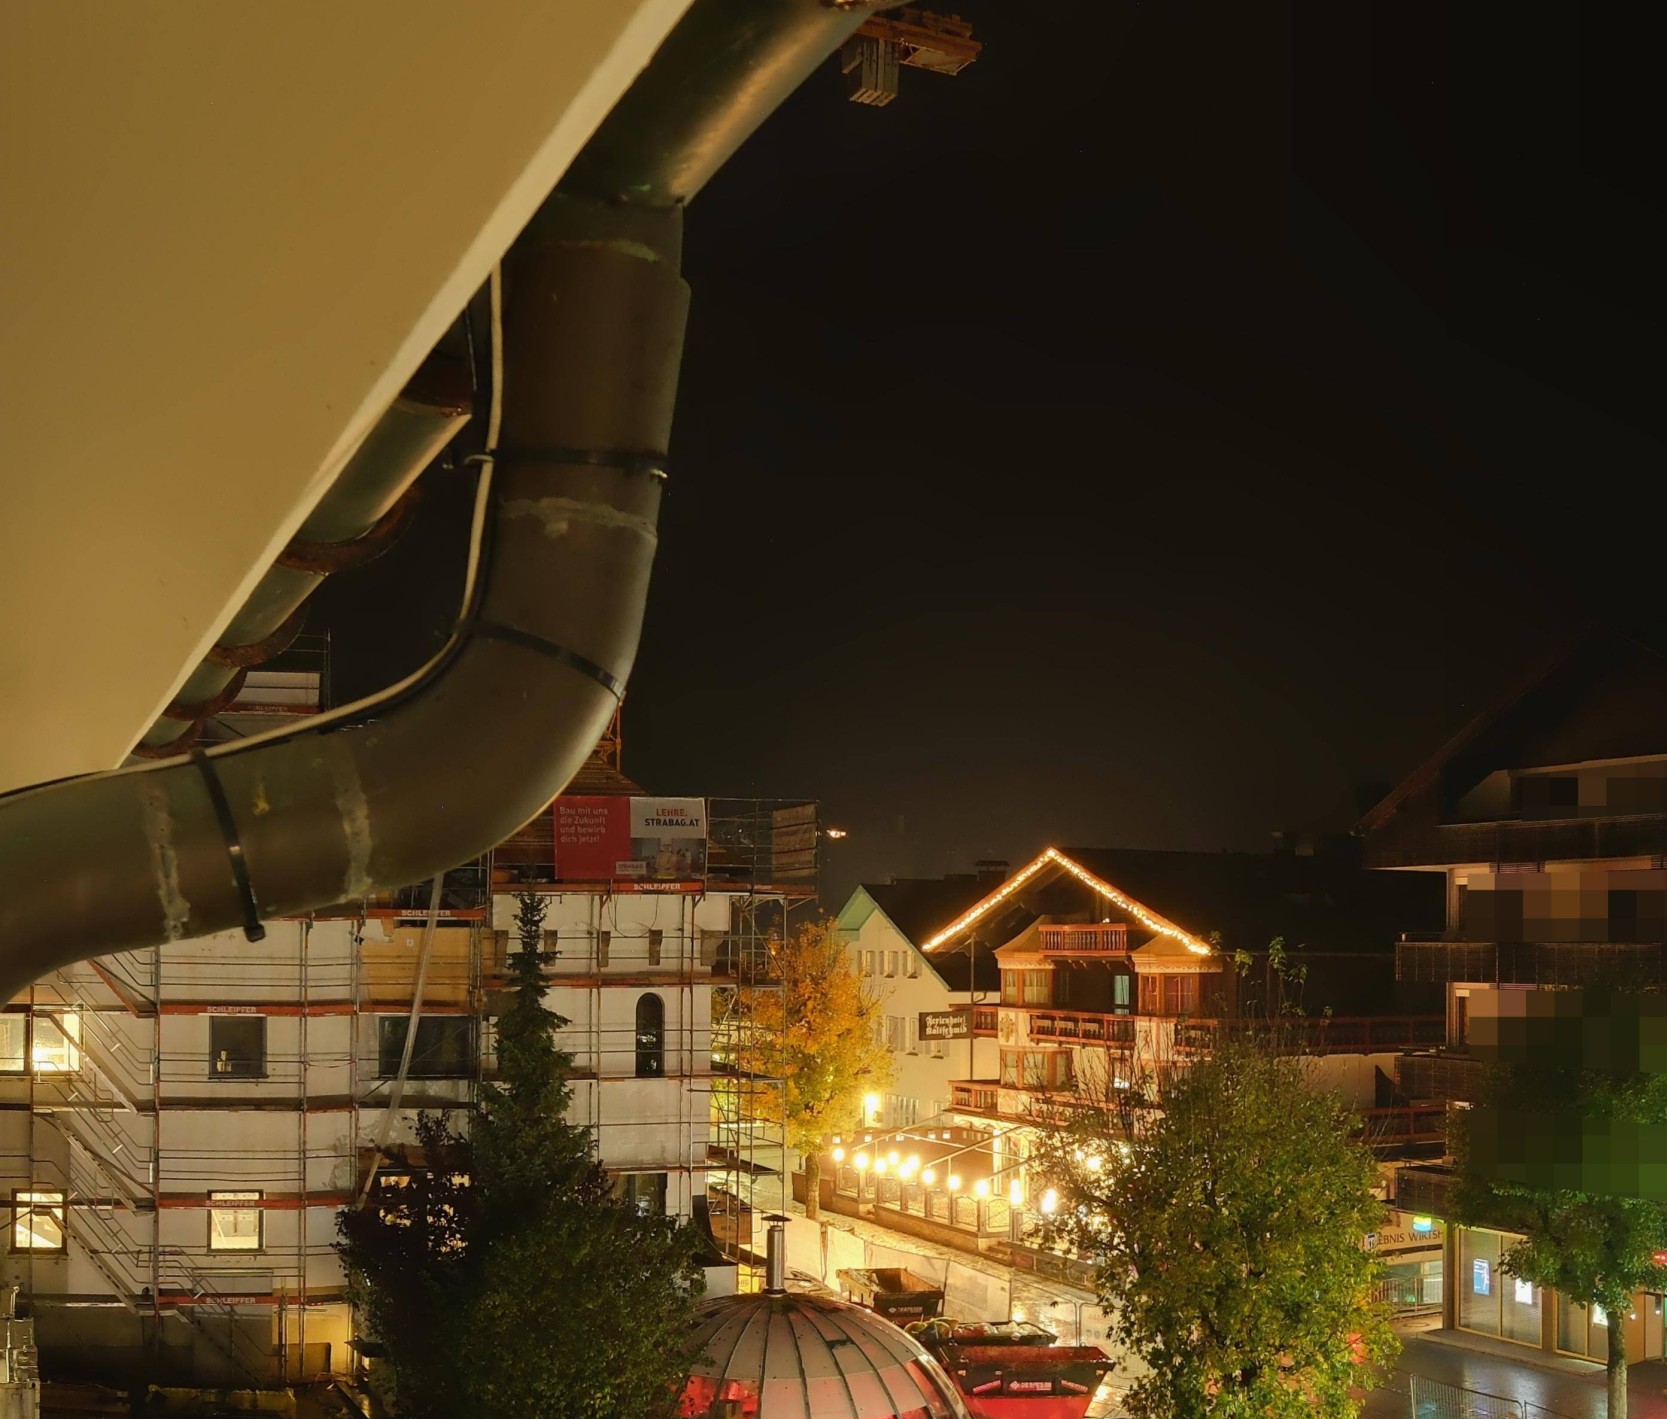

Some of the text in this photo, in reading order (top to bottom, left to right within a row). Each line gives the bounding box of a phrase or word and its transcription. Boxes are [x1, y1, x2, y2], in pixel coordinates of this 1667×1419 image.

[559, 806, 609, 815] Bau mit uns
[656, 808, 688, 817] LEHRE.
[560, 816, 606, 824] die Zukunft
[644, 818, 699, 827] STRABAG.AT
[560, 825, 606, 833] und bewirb
[560, 835, 600, 844] dich jetzt!
